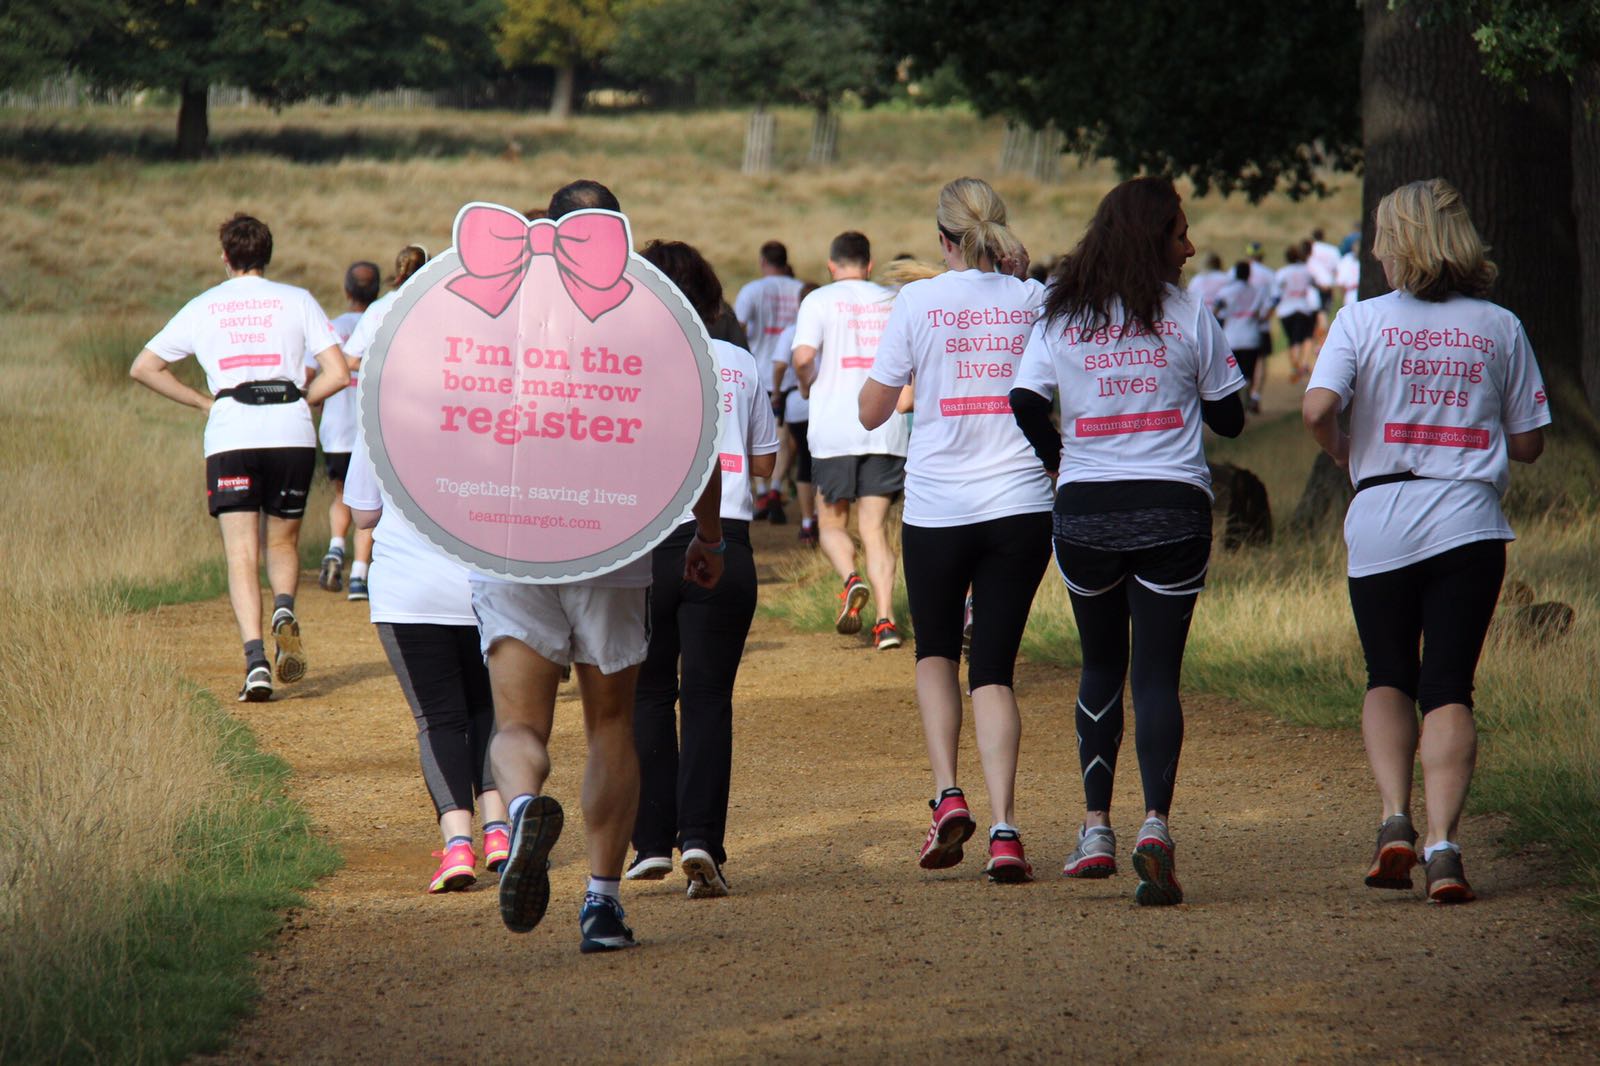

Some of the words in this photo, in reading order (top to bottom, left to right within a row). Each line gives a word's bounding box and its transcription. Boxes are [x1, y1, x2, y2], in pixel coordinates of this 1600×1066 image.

[220, 313, 273, 328] saving
[229, 330, 266, 344] lives
[945, 334, 1024, 355] saving
[1382, 327, 1496, 360] Together,
[444, 336, 513, 367] I'm
[523, 347, 571, 371] on
[581, 346, 643, 376] the
[1084, 345, 1168, 371] saving
[956, 361, 1013, 379] lives
[1401, 357, 1485, 384] saving
[442, 369, 513, 394] bone
[521, 379, 642, 403] marrow
[1097, 376, 1158, 398] lives
[1409, 383, 1469, 407] lives
[440, 401, 643, 445] register
[1081, 415, 1177, 433] teammargot.com
[1390, 428, 1483, 444] teammargot.com
[436, 478, 523, 499] Together,
[528, 486, 591, 505] saving
[593, 488, 638, 506] lives
[468, 510, 602, 530] teammargot.com
